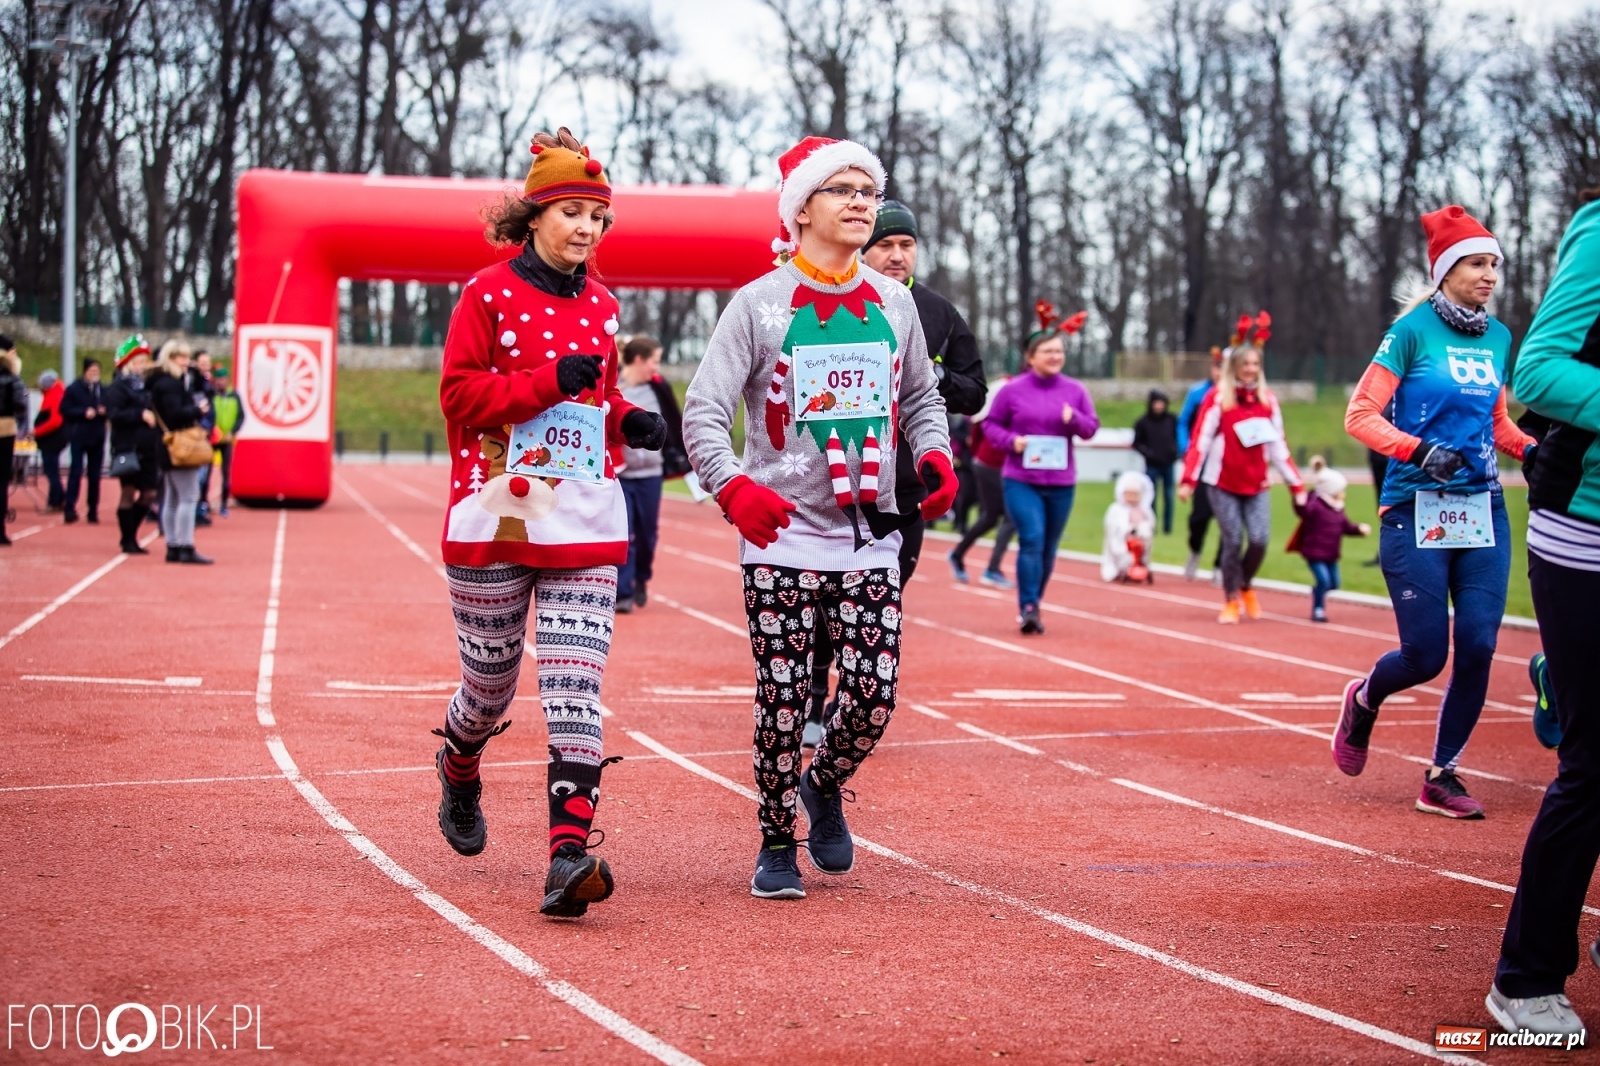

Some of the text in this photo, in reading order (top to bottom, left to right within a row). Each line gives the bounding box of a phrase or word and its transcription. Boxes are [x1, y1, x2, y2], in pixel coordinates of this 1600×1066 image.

[804, 359, 827, 368] Bieg
[828, 370, 864, 388] 057
[1460, 388, 1491, 397] RACIBÓRZ
[545, 426, 582, 449] 053
[1440, 510, 1468, 524] 064
